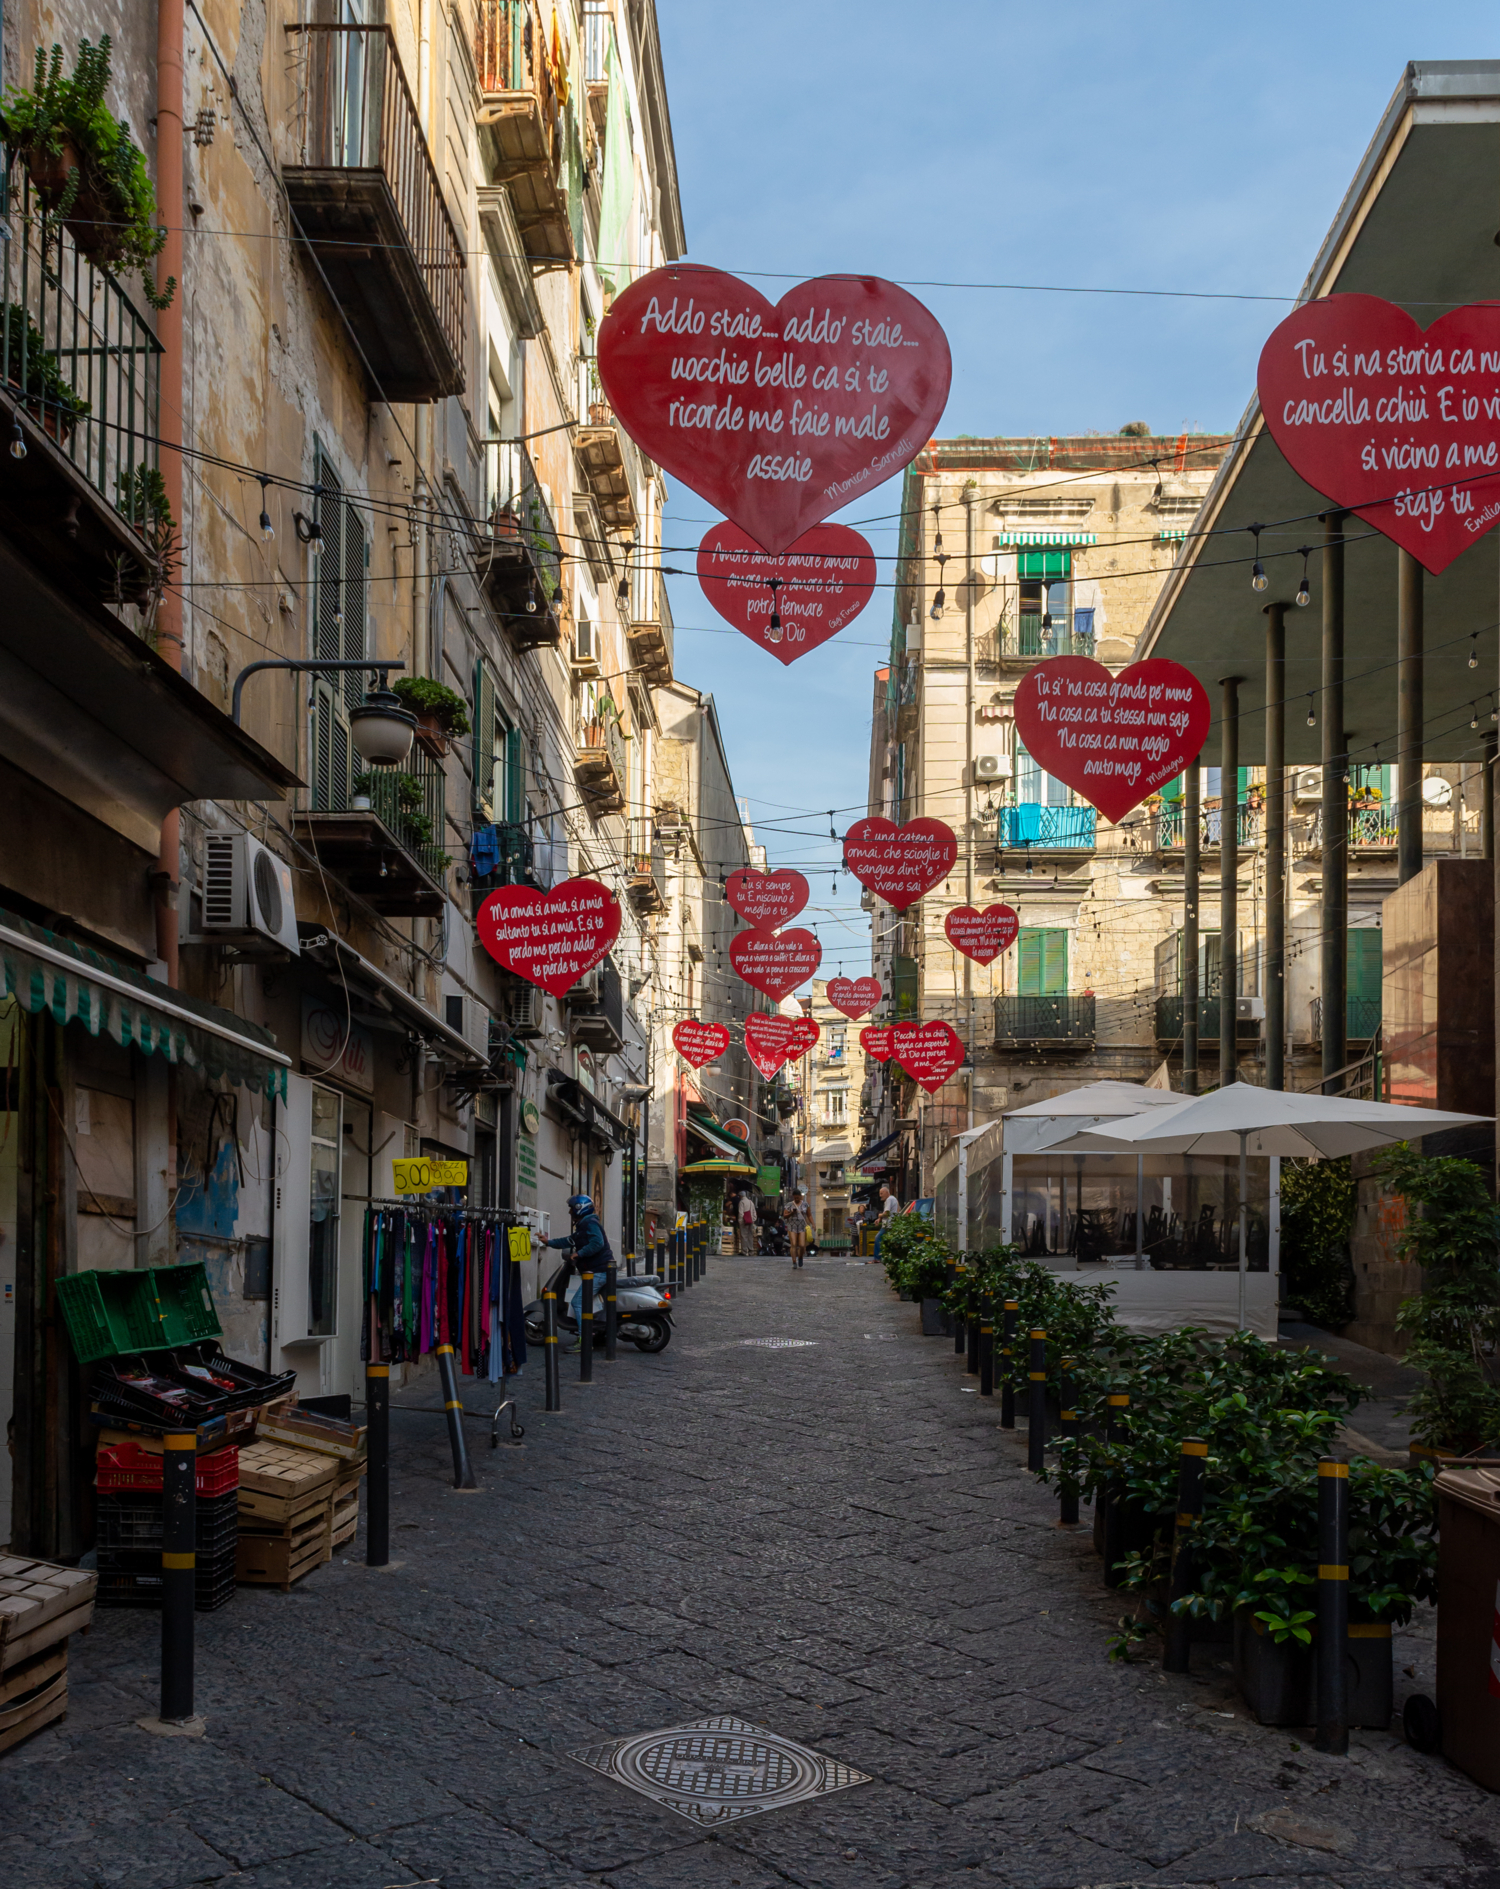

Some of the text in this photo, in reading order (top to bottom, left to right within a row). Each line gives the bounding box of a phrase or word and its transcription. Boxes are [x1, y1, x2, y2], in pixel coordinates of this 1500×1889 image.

[641, 297, 705, 334] Addo
[784, 307, 846, 344] addo'
[671, 348, 889, 392] uocchie belle ca si te
[1295, 339, 1328, 378] Tu
[1333, 344, 1349, 376] si
[1355, 350, 1382, 376] na
[1387, 343, 1444, 375] storia
[1450, 349, 1475, 374] ca
[669, 395, 890, 440] ricorde me faie male
[1283, 387, 1370, 425] cancella
[1376, 385, 1429, 423] cchiù
[1437, 386, 1458, 422] E
[1462, 389, 1478, 420] io
[747, 451, 813, 481] assaie
[1362, 438, 1498, 470] si vicino a me
[823, 438, 915, 499] Monica Sarnelli
[1394, 486, 1474, 531] staje tu
[712, 542, 748, 563] Amore
[788, 555, 821, 567] amore
[824, 555, 859, 570] amaro
[727, 573, 760, 588] amore
[789, 578, 823, 593] amore
[826, 574, 843, 593] che
[747, 594, 823, 620] potrà fermare
[829, 601, 860, 628] Gigi Finizio
[786, 622, 805, 641] Dio
[1034, 673, 1192, 707] Tu si' 'na cosa grande pe' mme
[1038, 700, 1189, 737] Na cosa ca tu stessa nun saje
[1057, 727, 1169, 761] Na cosa ca nun aggio
[1084, 759, 1141, 786] avuto maje
[1146, 756, 1184, 785] Modugno
[863, 825, 934, 843] È una catena
[884, 846, 901, 858] che
[904, 847, 940, 865] scioglie
[943, 847, 949, 860] il
[857, 864, 894, 880] sangue
[897, 862, 922, 875] dint'
[737, 892, 745, 901] tu
[748, 891, 754, 902] E
[756, 892, 787, 902] nisciuno
[766, 882, 791, 894] sempe
[907, 880, 921, 891] sai
[490, 894, 603, 921] Ma ormai si a mia, si a mia
[744, 903, 771, 919] meglio
[780, 906, 788, 915] te
[496, 915, 604, 940] sultanto tu si a mia, E si te
[509, 941, 532, 965] perdo
[533, 943, 547, 956] me
[548, 937, 571, 961] perdo
[748, 941, 796, 950] E allora Che vale
[532, 958, 579, 982] te pierde tu
[742, 964, 752, 974] Che
[753, 965, 764, 973] vale
[771, 966, 784, 976] pena
[908, 1050, 920, 1058] Dio
[395, 1164, 430, 1190] 5.00
[509, 1232, 531, 1258] 5.00
